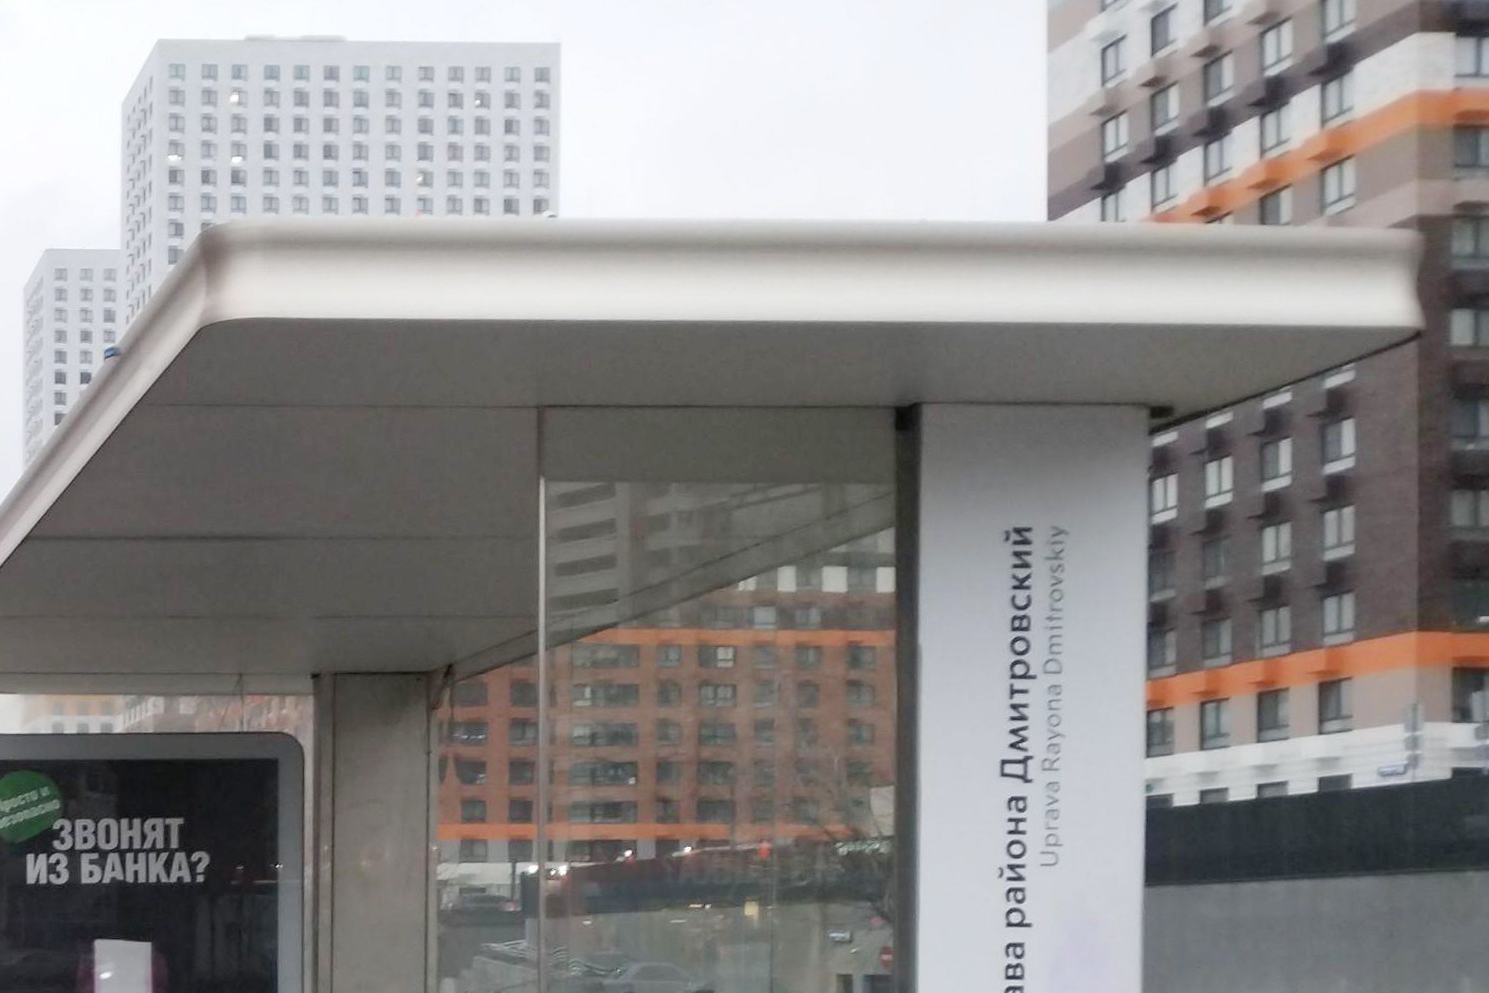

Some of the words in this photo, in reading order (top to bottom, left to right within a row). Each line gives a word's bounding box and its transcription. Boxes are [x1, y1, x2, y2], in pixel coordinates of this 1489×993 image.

[1043, 525, 1070, 674] Dmitrovskiy
[999, 526, 1037, 783] Дмитровский
[1041, 684, 1065, 771] Rayona
[25, 852, 70, 885] ИЗ
[80, 850, 211, 885] БАНКА?
[52, 817, 185, 851] ЗВОНЯТ
[997, 795, 1032, 928] района
[1040, 781, 1063, 867] Uprava
